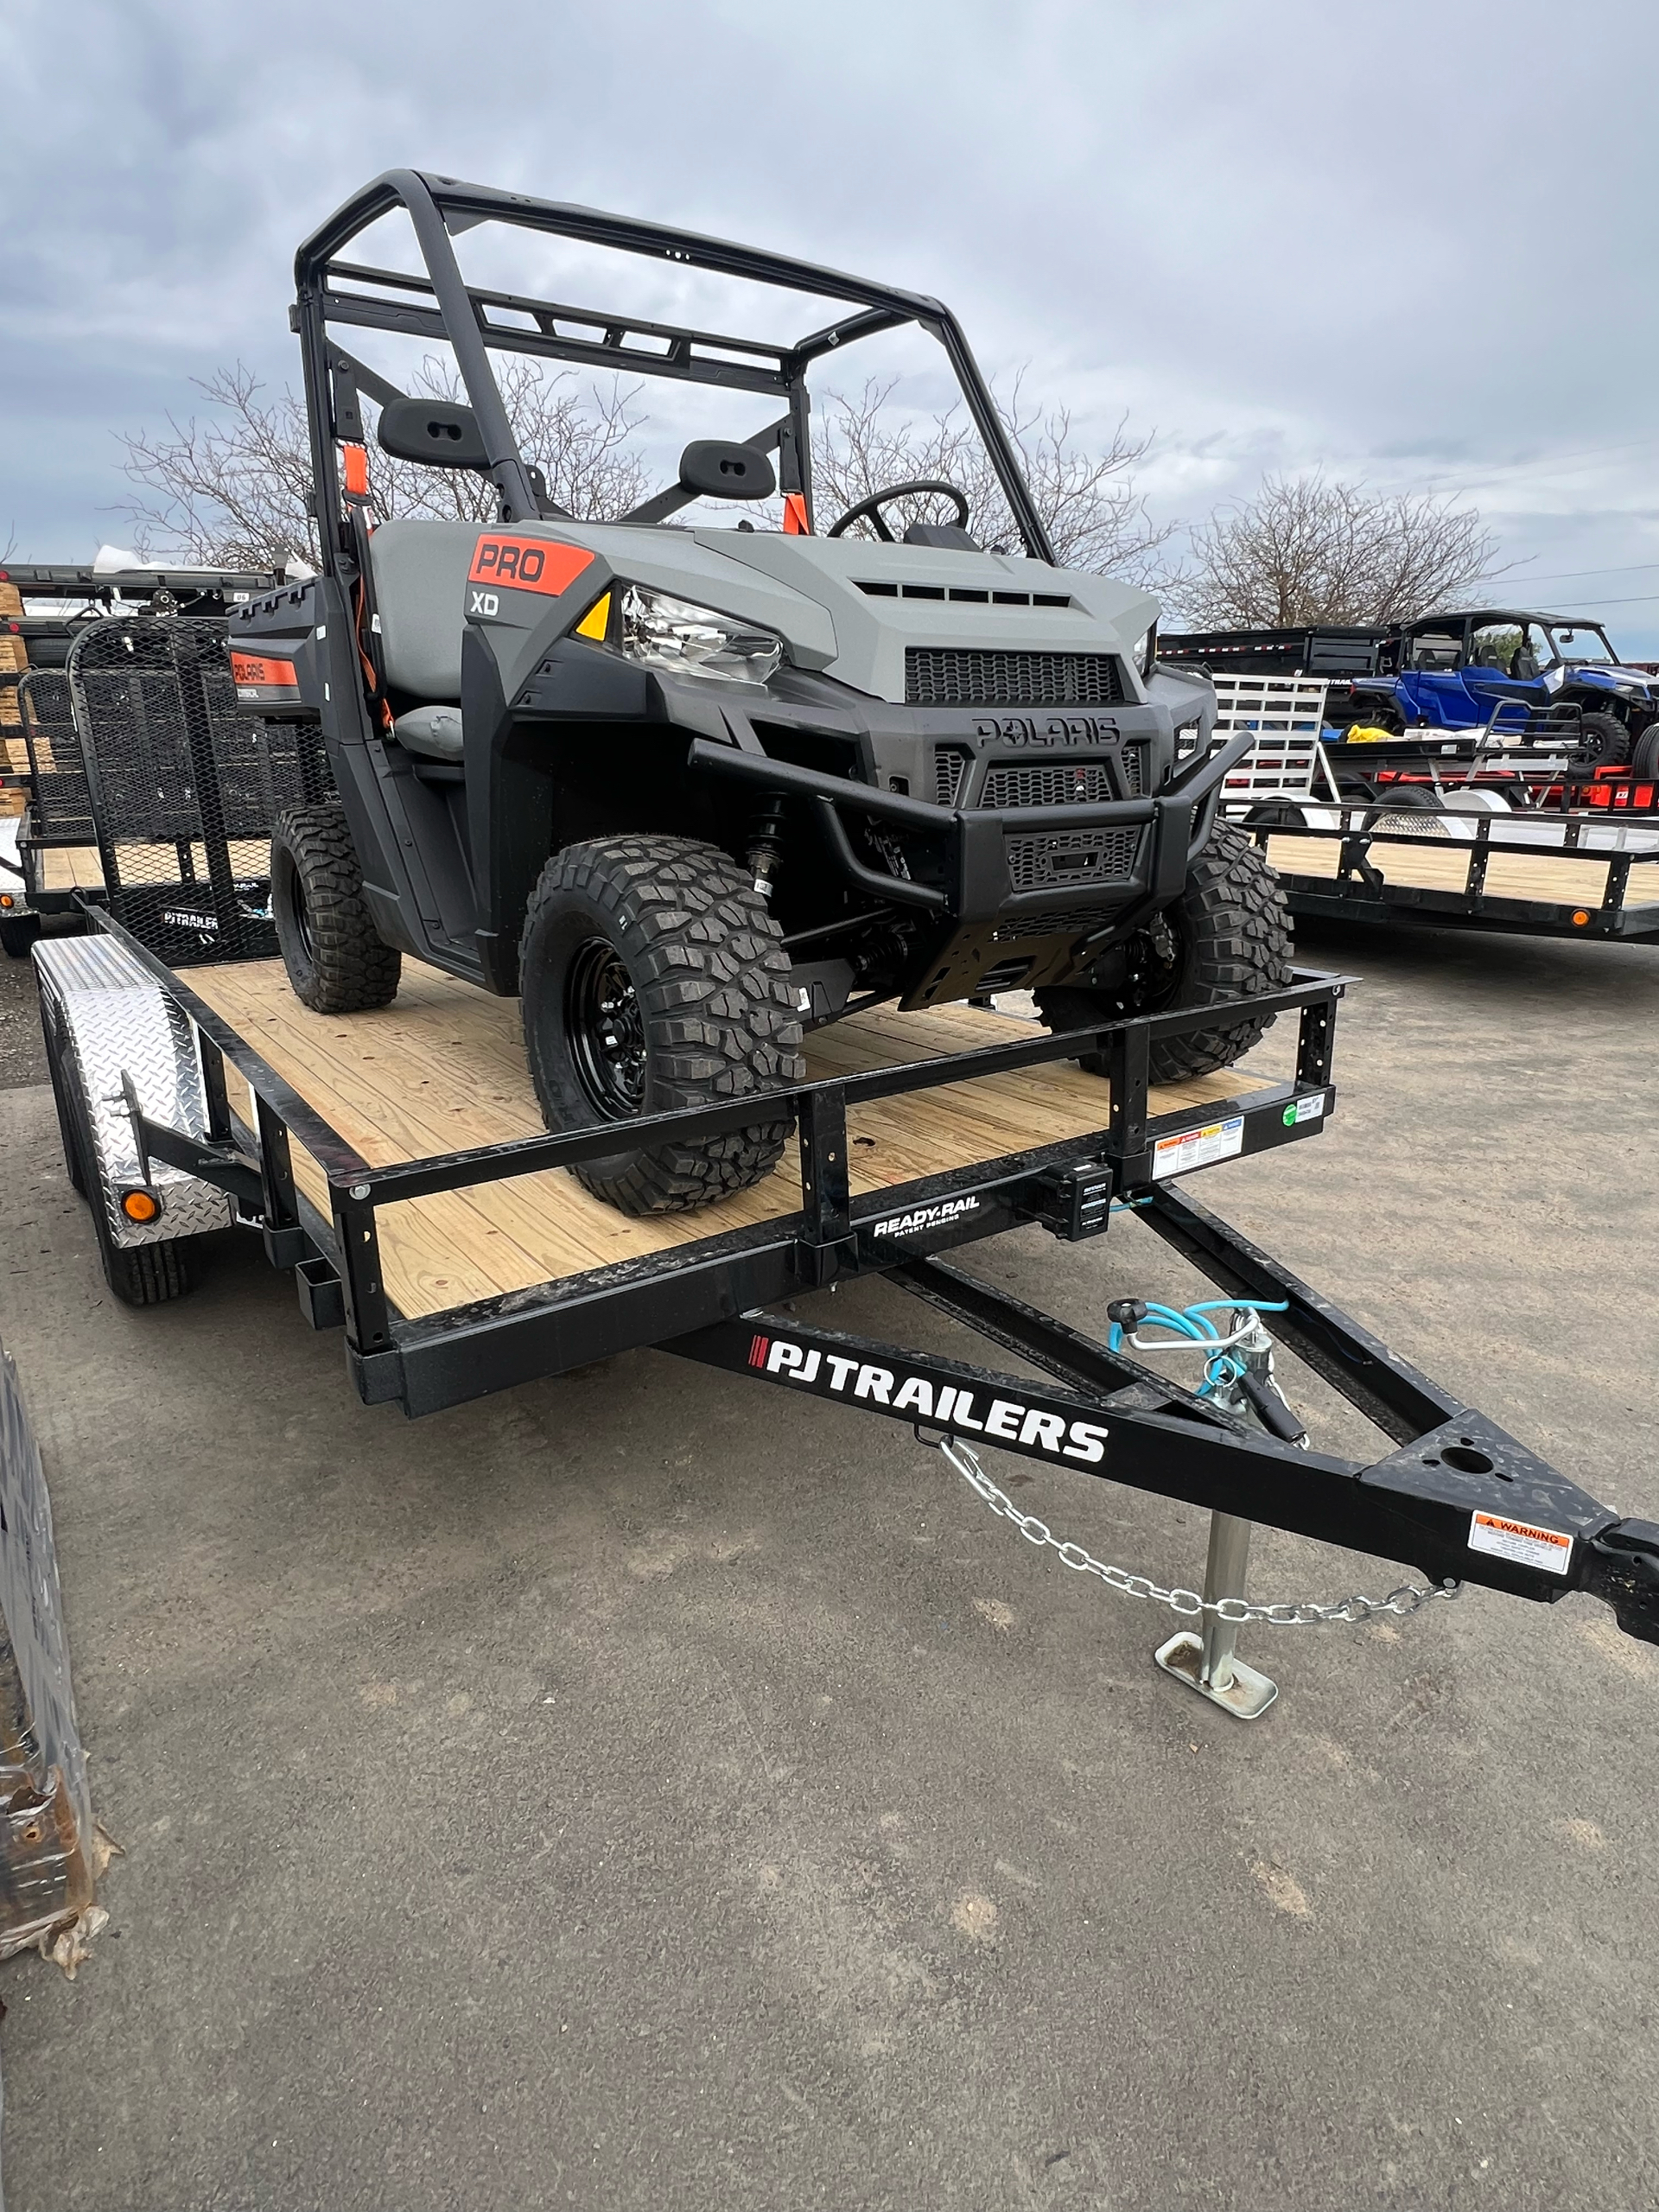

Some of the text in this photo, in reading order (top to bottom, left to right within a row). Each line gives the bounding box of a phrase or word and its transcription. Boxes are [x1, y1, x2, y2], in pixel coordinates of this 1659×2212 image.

[476, 543, 545, 582] PRO
[470, 590, 499, 616] XD
[972, 716, 1121, 748] POLARIS
[894, 1224, 924, 1237] PATENT
[766, 1340, 1109, 1463] PJ TRAILERS
[1500, 1522, 1559, 1545] WARNING
